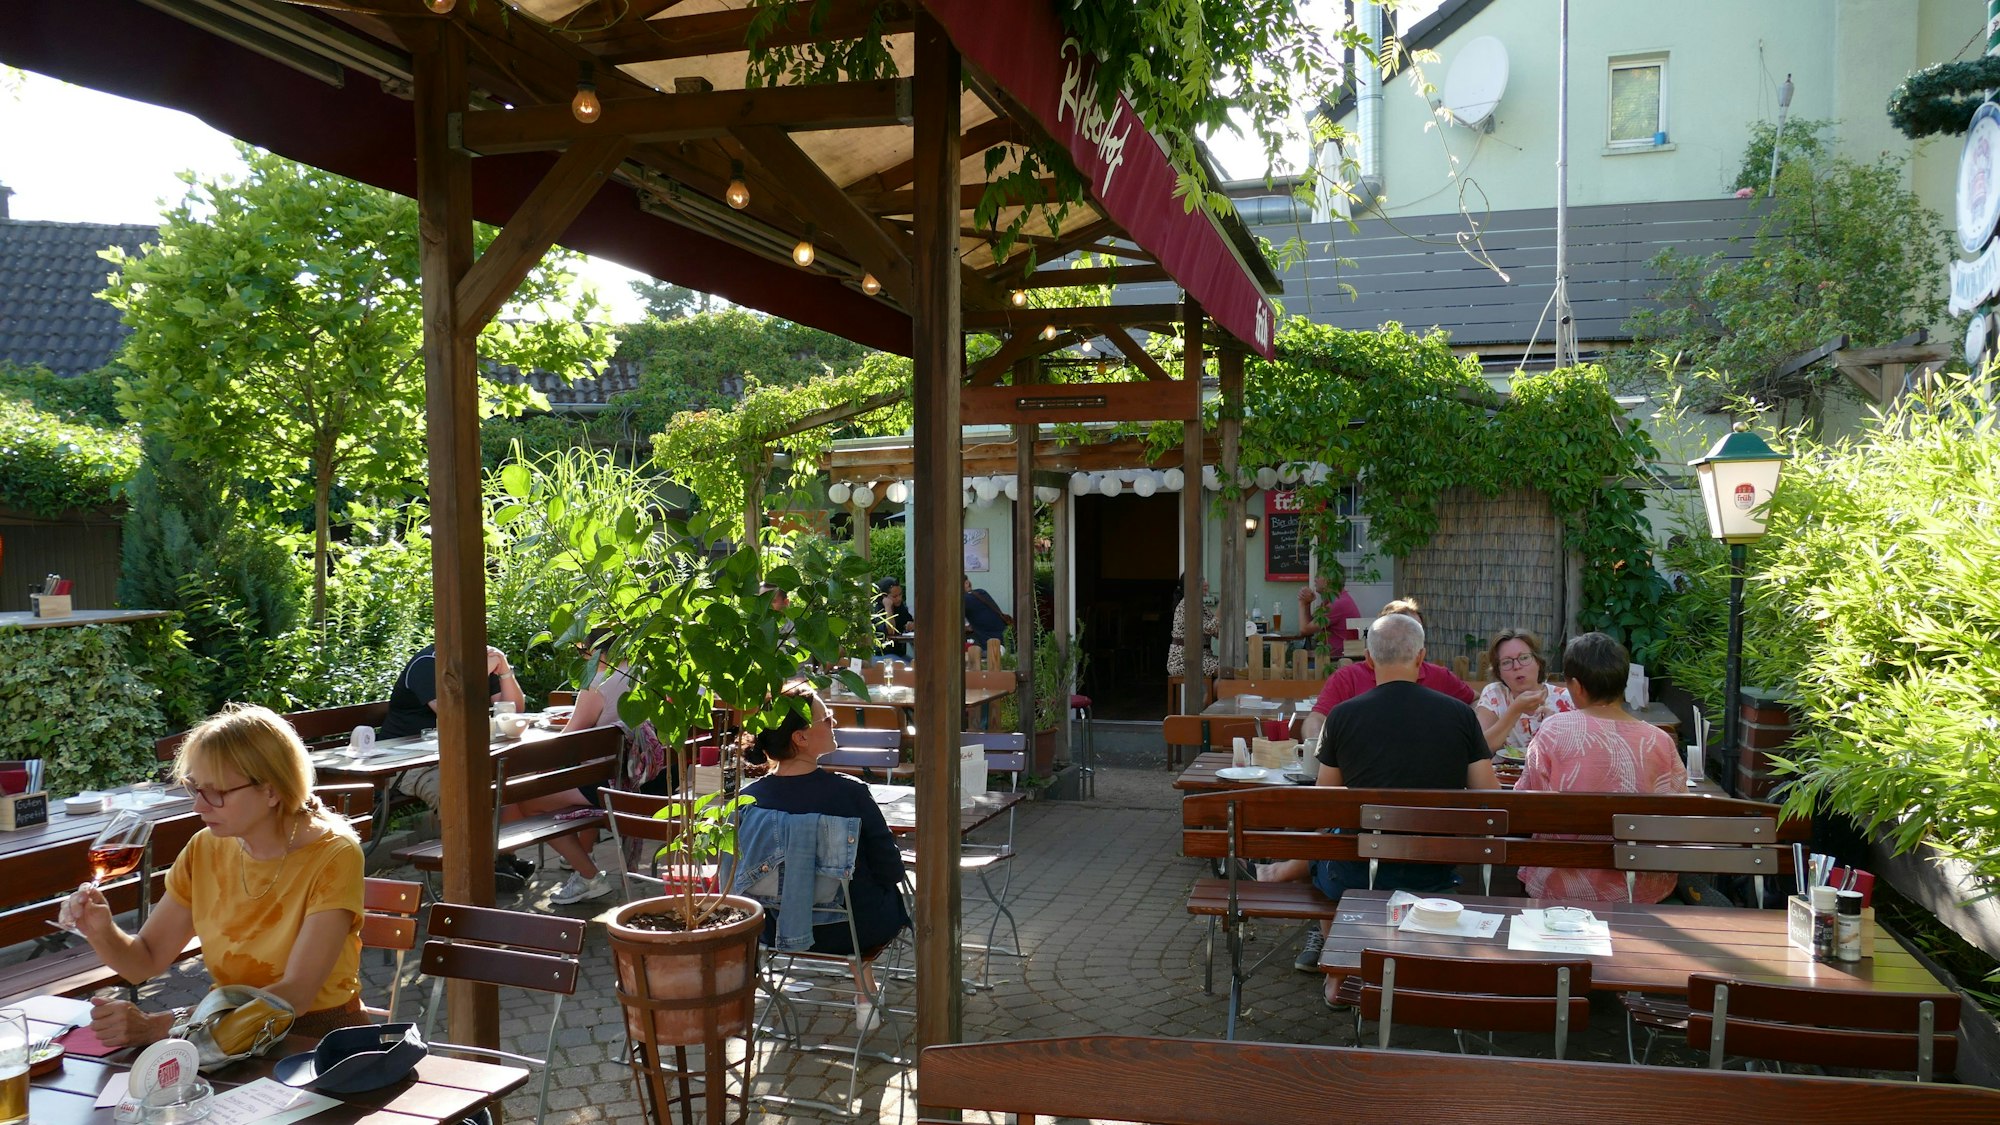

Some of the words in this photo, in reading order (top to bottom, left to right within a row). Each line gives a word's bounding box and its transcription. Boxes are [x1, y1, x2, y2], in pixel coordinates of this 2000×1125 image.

[1737, 494, 1752, 502] früh
[16, 800, 42, 809] Guten
[1791, 903, 1808, 922] Guten
